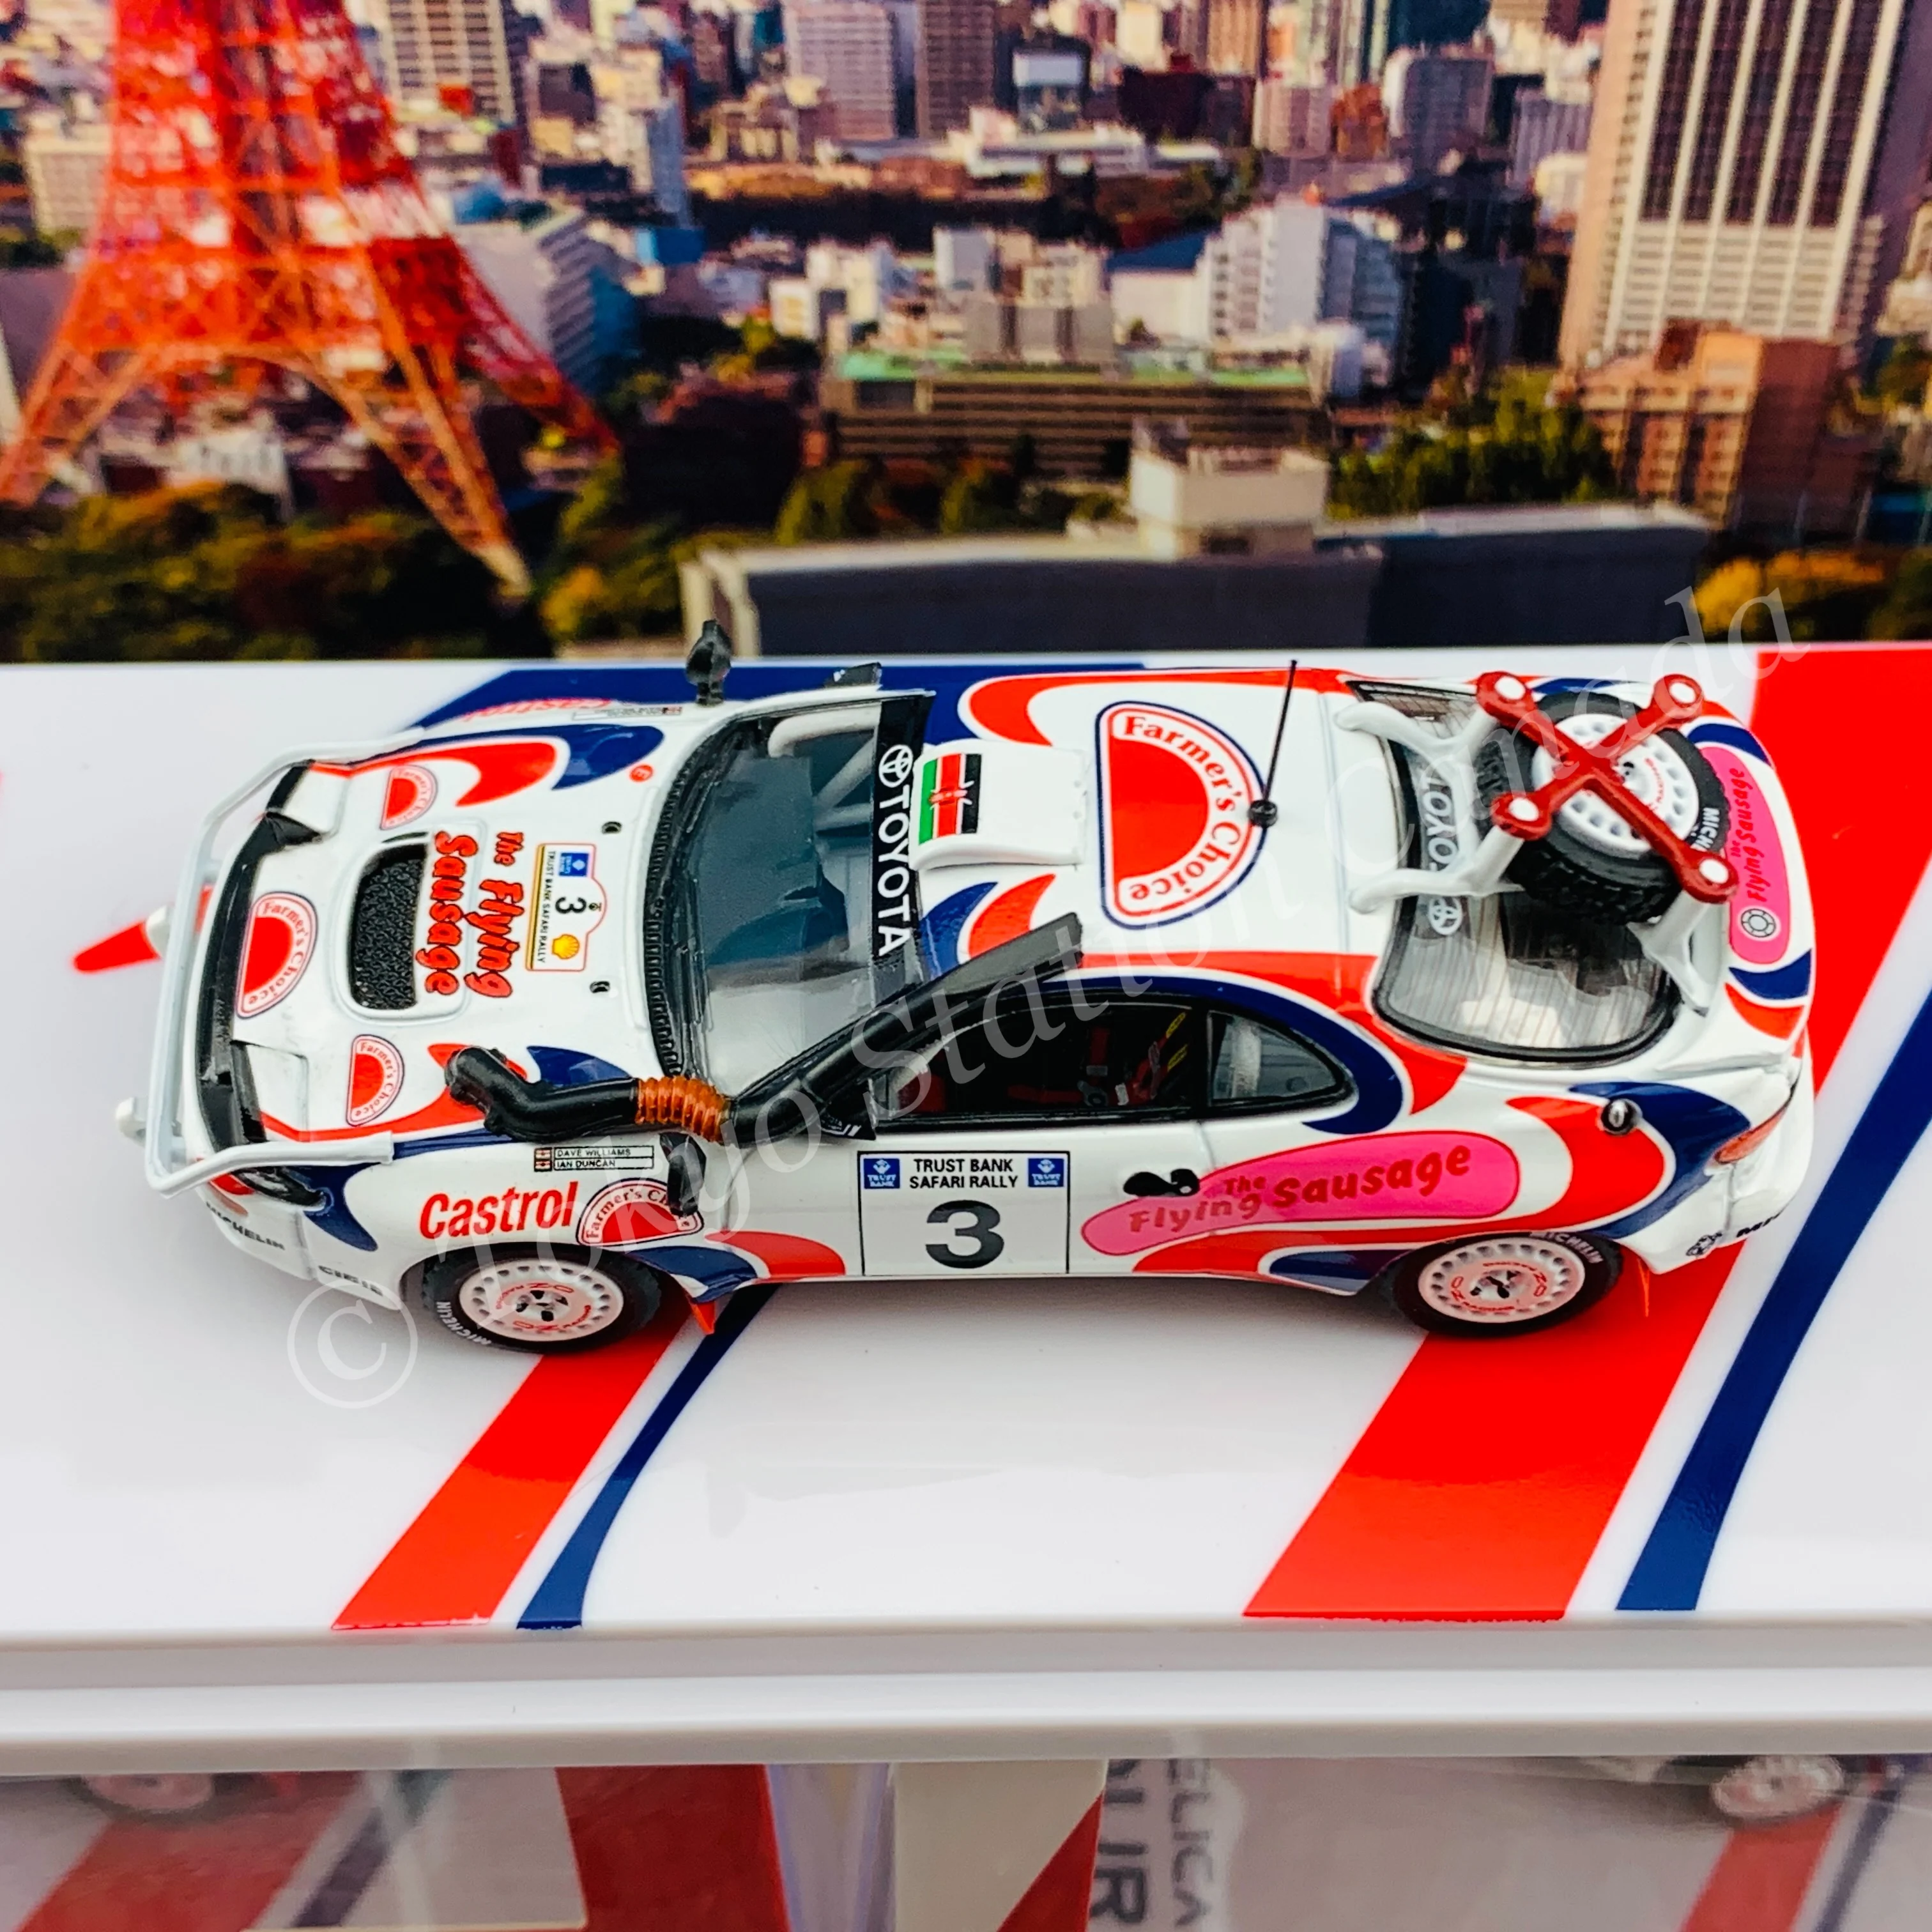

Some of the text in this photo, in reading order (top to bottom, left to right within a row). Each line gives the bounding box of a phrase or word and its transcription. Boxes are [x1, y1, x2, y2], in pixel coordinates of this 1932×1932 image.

[1124, 716, 1244, 900] Farmer's Choice
[1419, 770, 1459, 871] OYOT
[877, 784, 911, 956] TOYOTA
[415, 831, 479, 996] Sausage
[537, 850, 556, 963] TRUST BANK SAFARI RALLY
[555, 897, 587, 914] 3
[247, 901, 309, 1005] Farmer's Choice
[463, 878, 525, 999] Flying
[355, 1042, 397, 1116] Farmer's Choice
[575, 1160, 616, 1168] DUNCAN
[586, 1149, 631, 1157] WILLIAMS
[910, 1176, 1018, 1188] SAFARI RALLY
[914, 1159, 1013, 1172] TRUST BANK
[1224, 1174, 1266, 1195] The
[420, 1181, 578, 1239] Castrol
[585, 1189, 642, 1239] Farmer's
[926, 1199, 1004, 1269] 3
[1130, 1192, 1263, 1233] Flying
